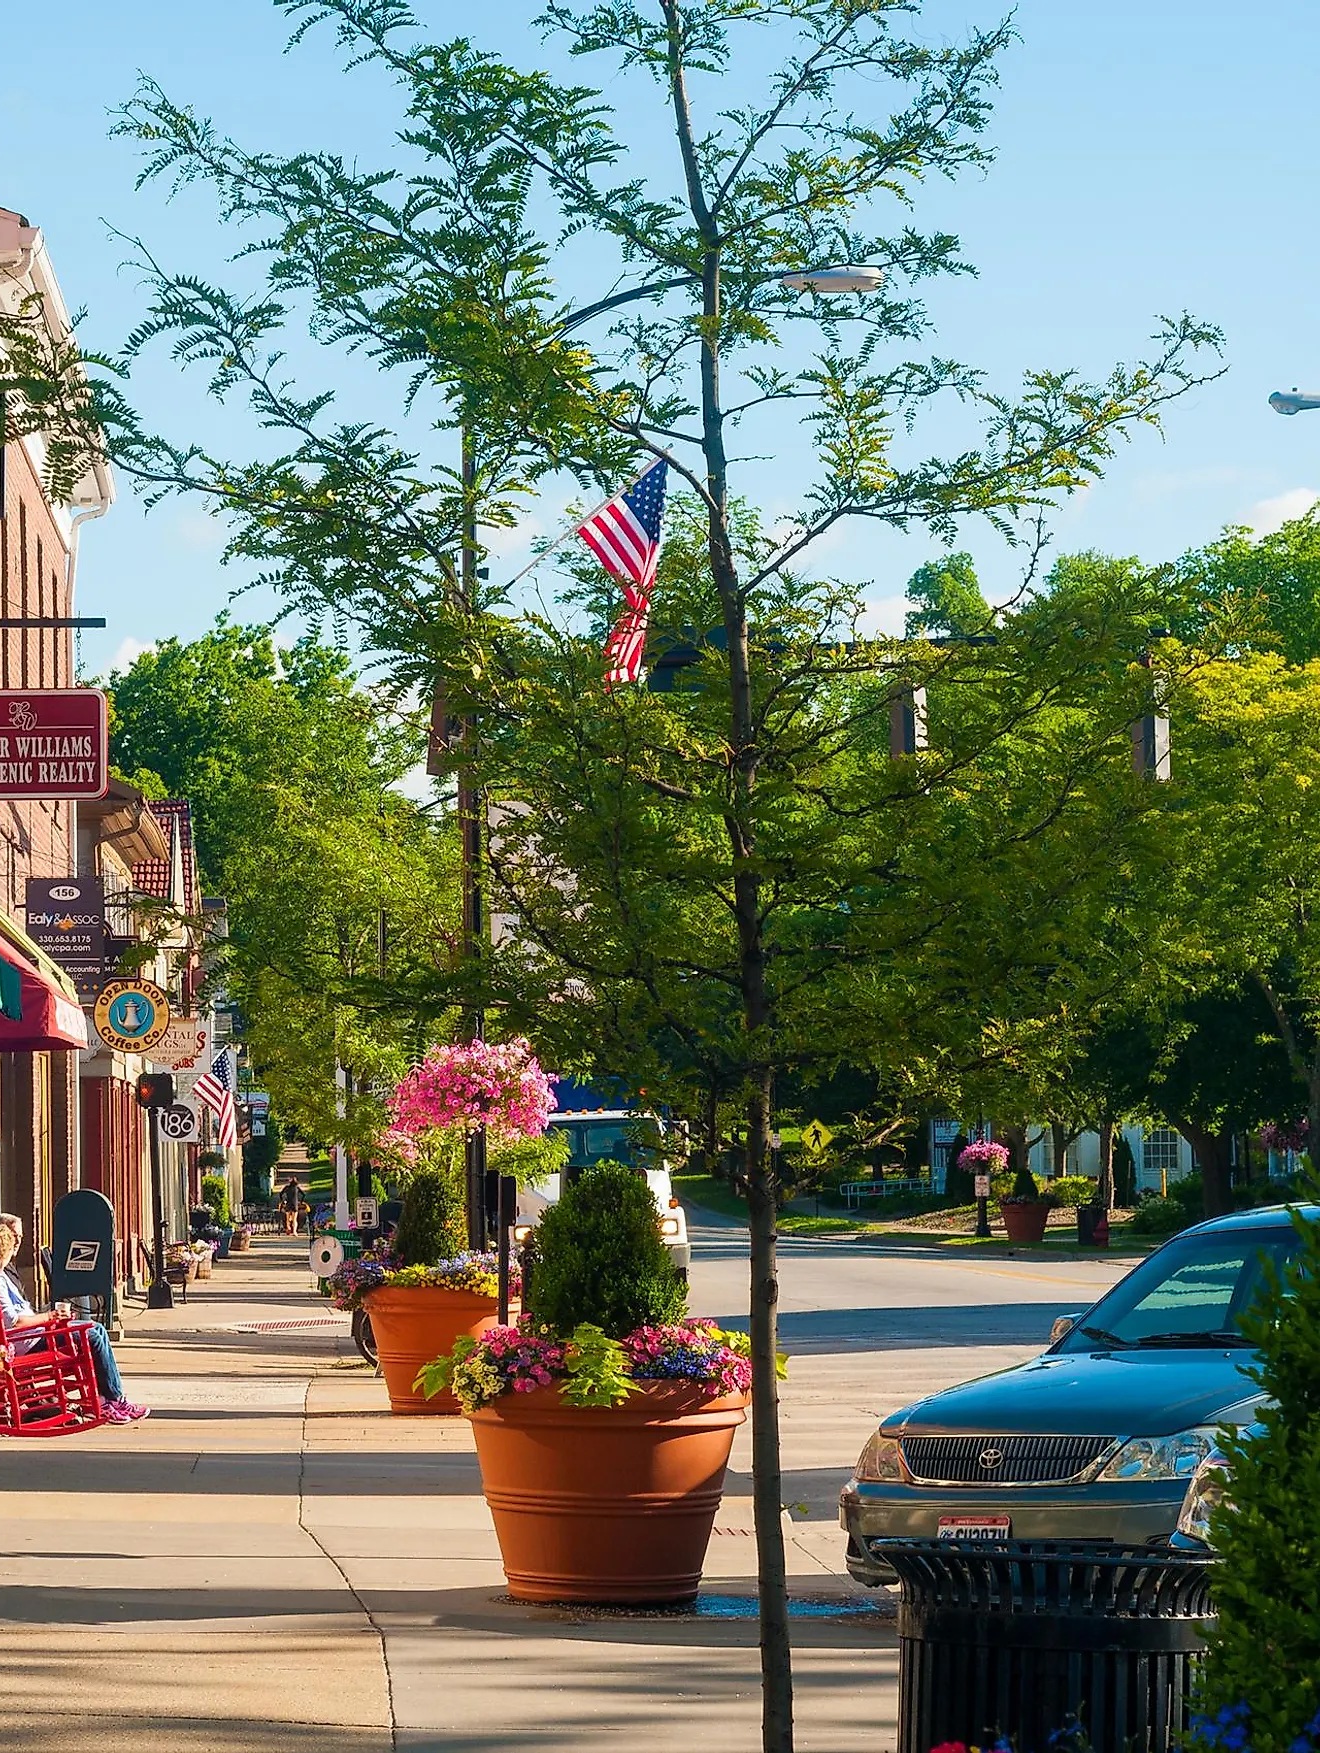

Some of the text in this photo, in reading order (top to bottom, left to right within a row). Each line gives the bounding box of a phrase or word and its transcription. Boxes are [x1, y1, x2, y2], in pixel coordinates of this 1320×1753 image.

[16, 736, 92, 758] WILLIAMS
[37, 761, 97, 783] REALTY
[55, 888, 75, 897] 156
[28, 912, 53, 928] Ealy
[65, 966, 101, 974] Accounting
[100, 981, 164, 1007] OPEN DOOR
[101, 1026, 163, 1050] Coffee Co.
[163, 1113, 194, 1136] 186
